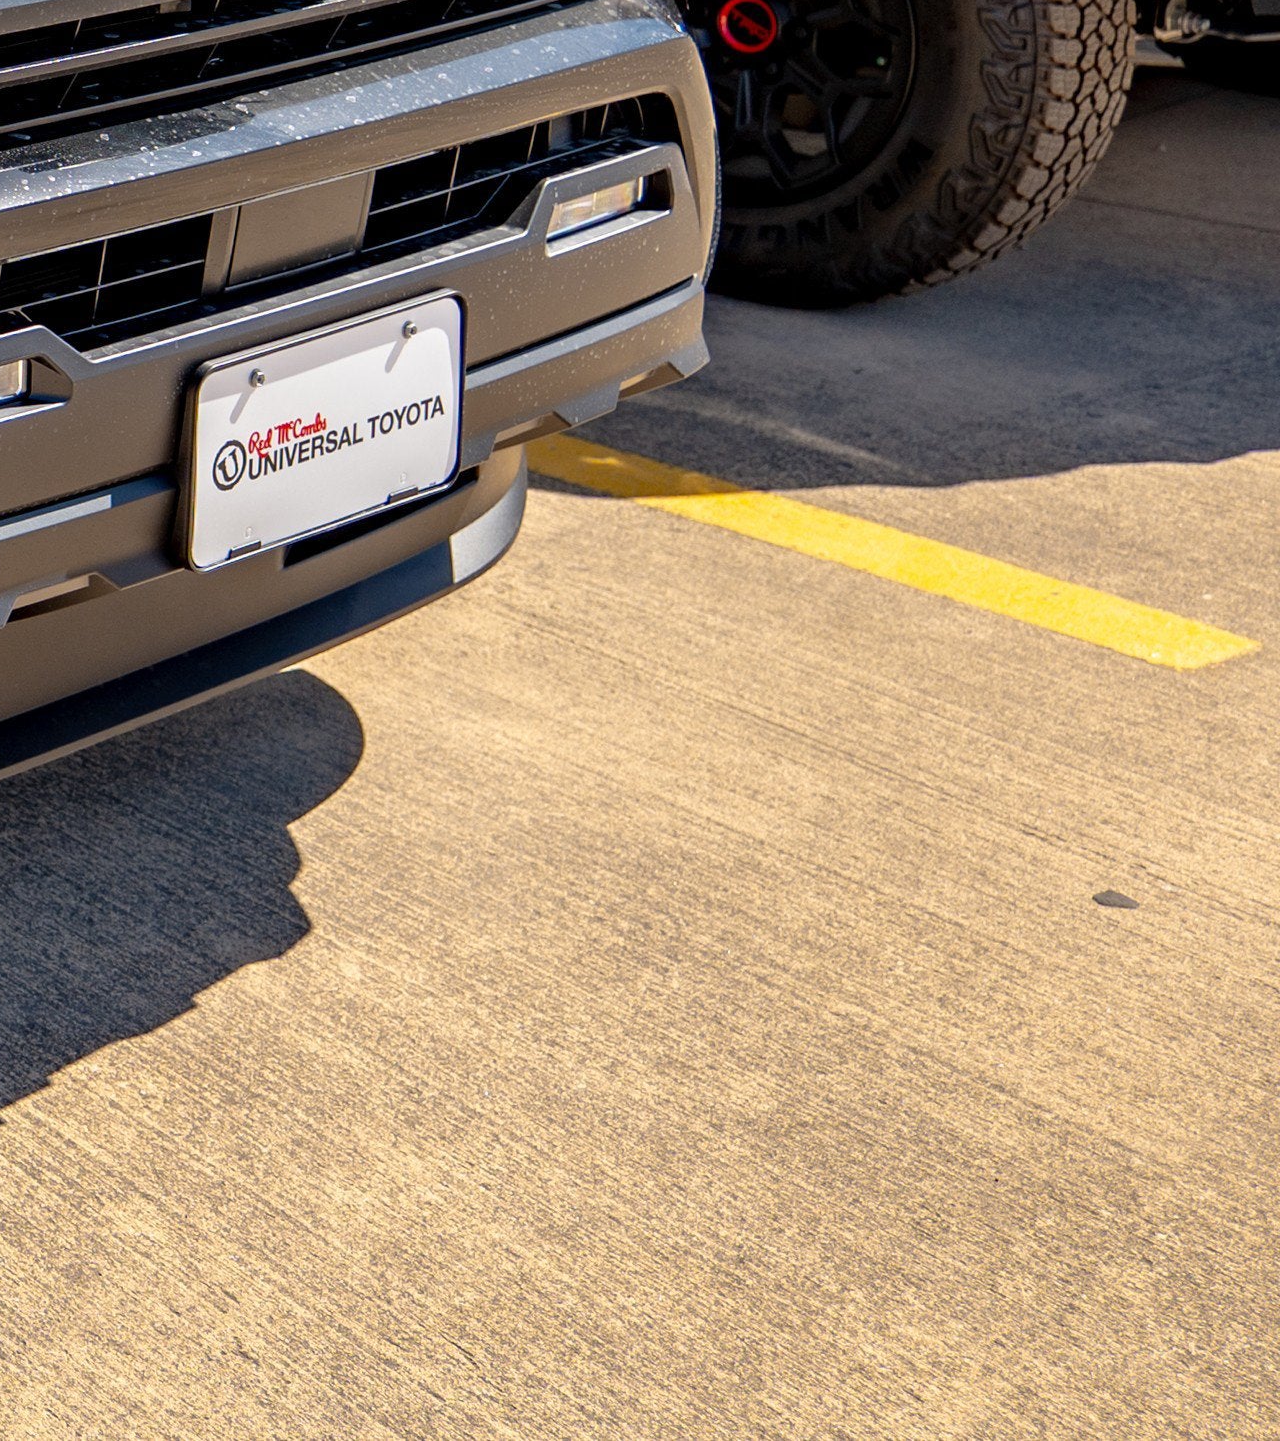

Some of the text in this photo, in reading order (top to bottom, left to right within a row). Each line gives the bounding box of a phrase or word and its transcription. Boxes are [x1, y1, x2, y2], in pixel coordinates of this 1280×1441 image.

[248, 412, 327, 456] Red McCombs
[248, 395, 445, 480] UNIVERSAL TOYOTA
